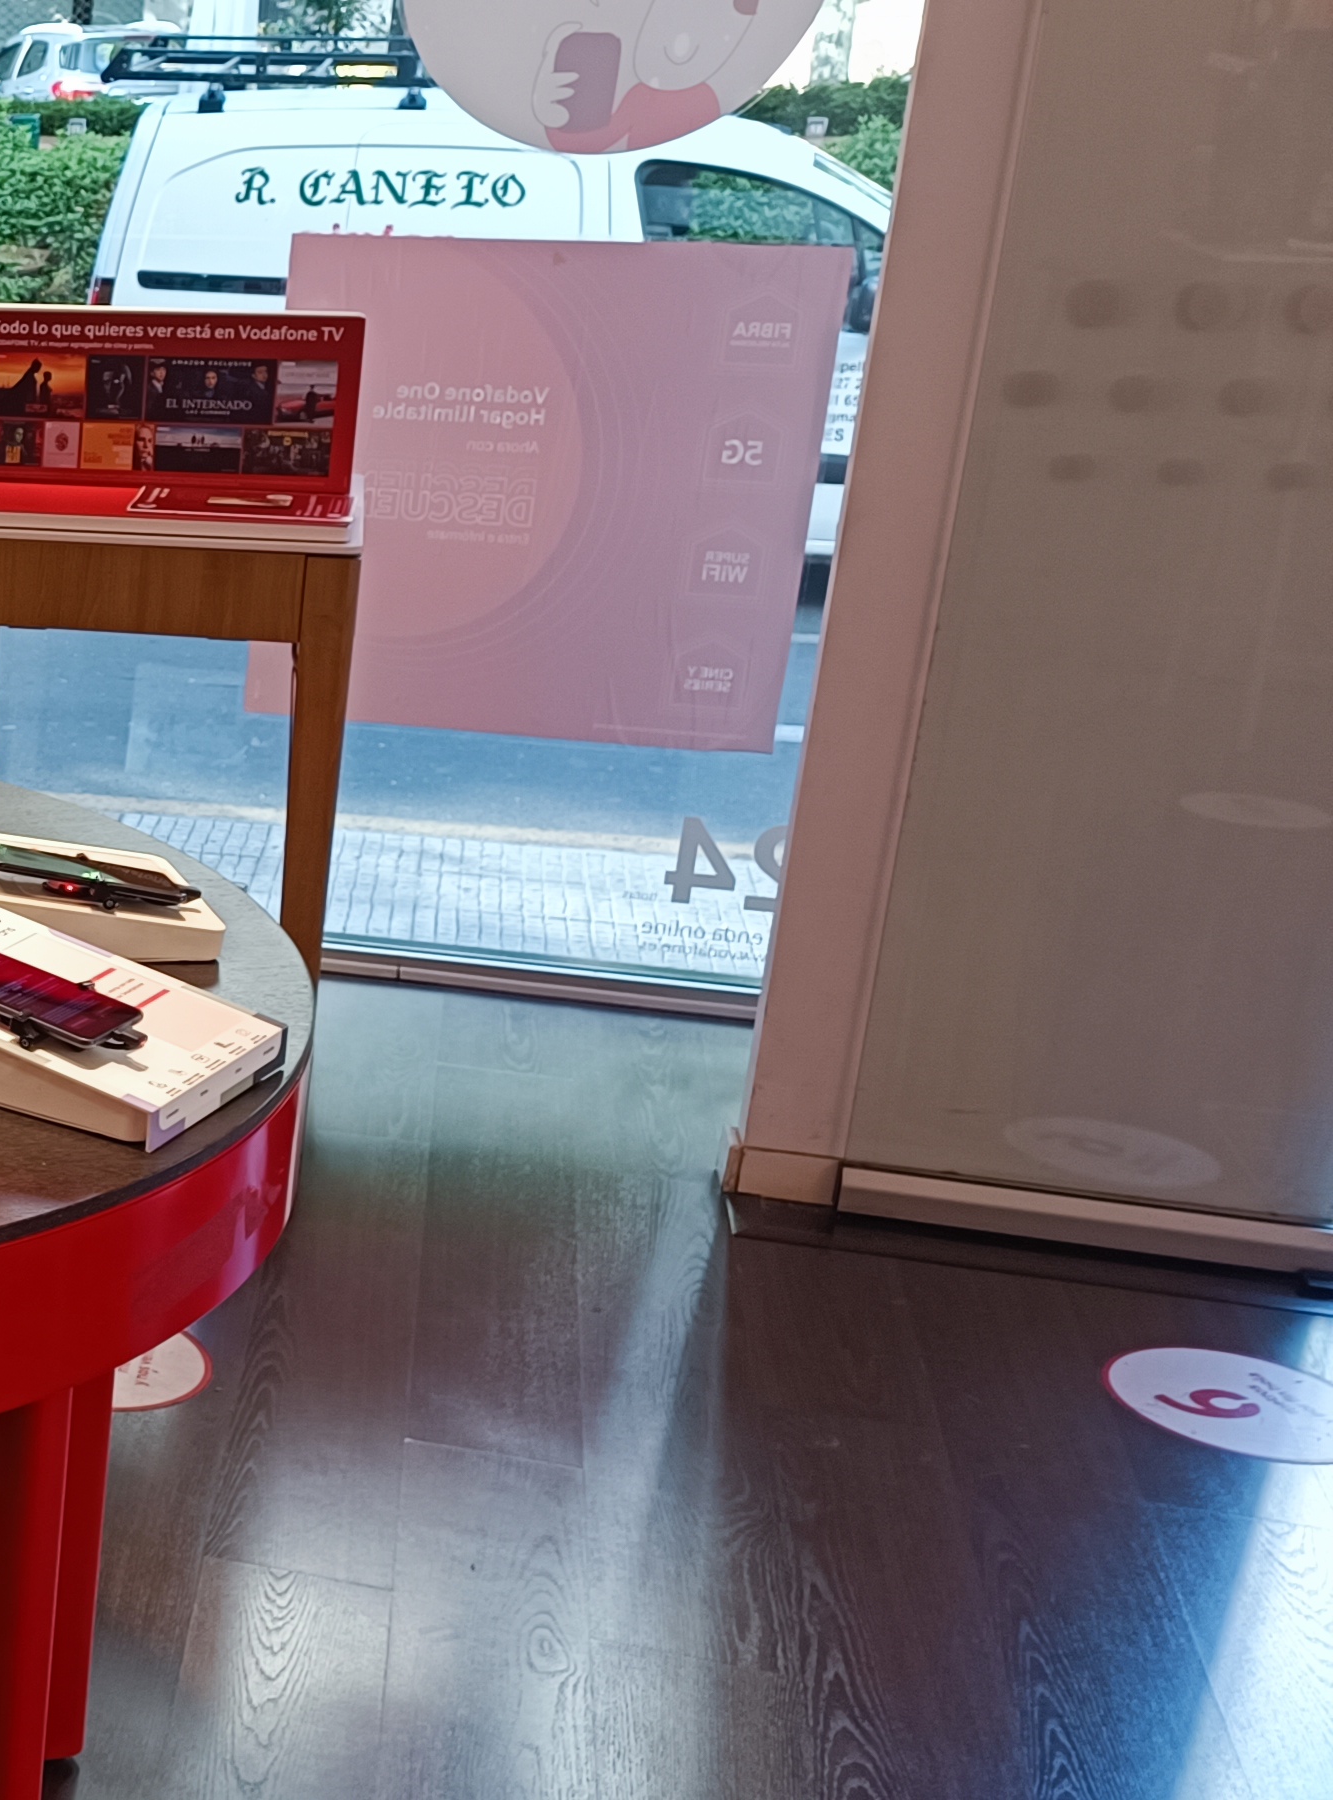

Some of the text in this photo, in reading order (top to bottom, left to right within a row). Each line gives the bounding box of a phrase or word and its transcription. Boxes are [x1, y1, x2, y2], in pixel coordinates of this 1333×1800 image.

[235, 166, 276, 206] R.
[33, 320, 48, 336] lo
[51, 325, 82, 339] que
[85, 322, 144, 340] quieres
[147, 326, 174, 338] ver
[176, 323, 211, 340] está
[214, 326, 234, 340] en
[238, 325, 318, 341] Vodafone
[321, 326, 345, 342] TV
[165, 398, 253, 411] EL INTERNADO
